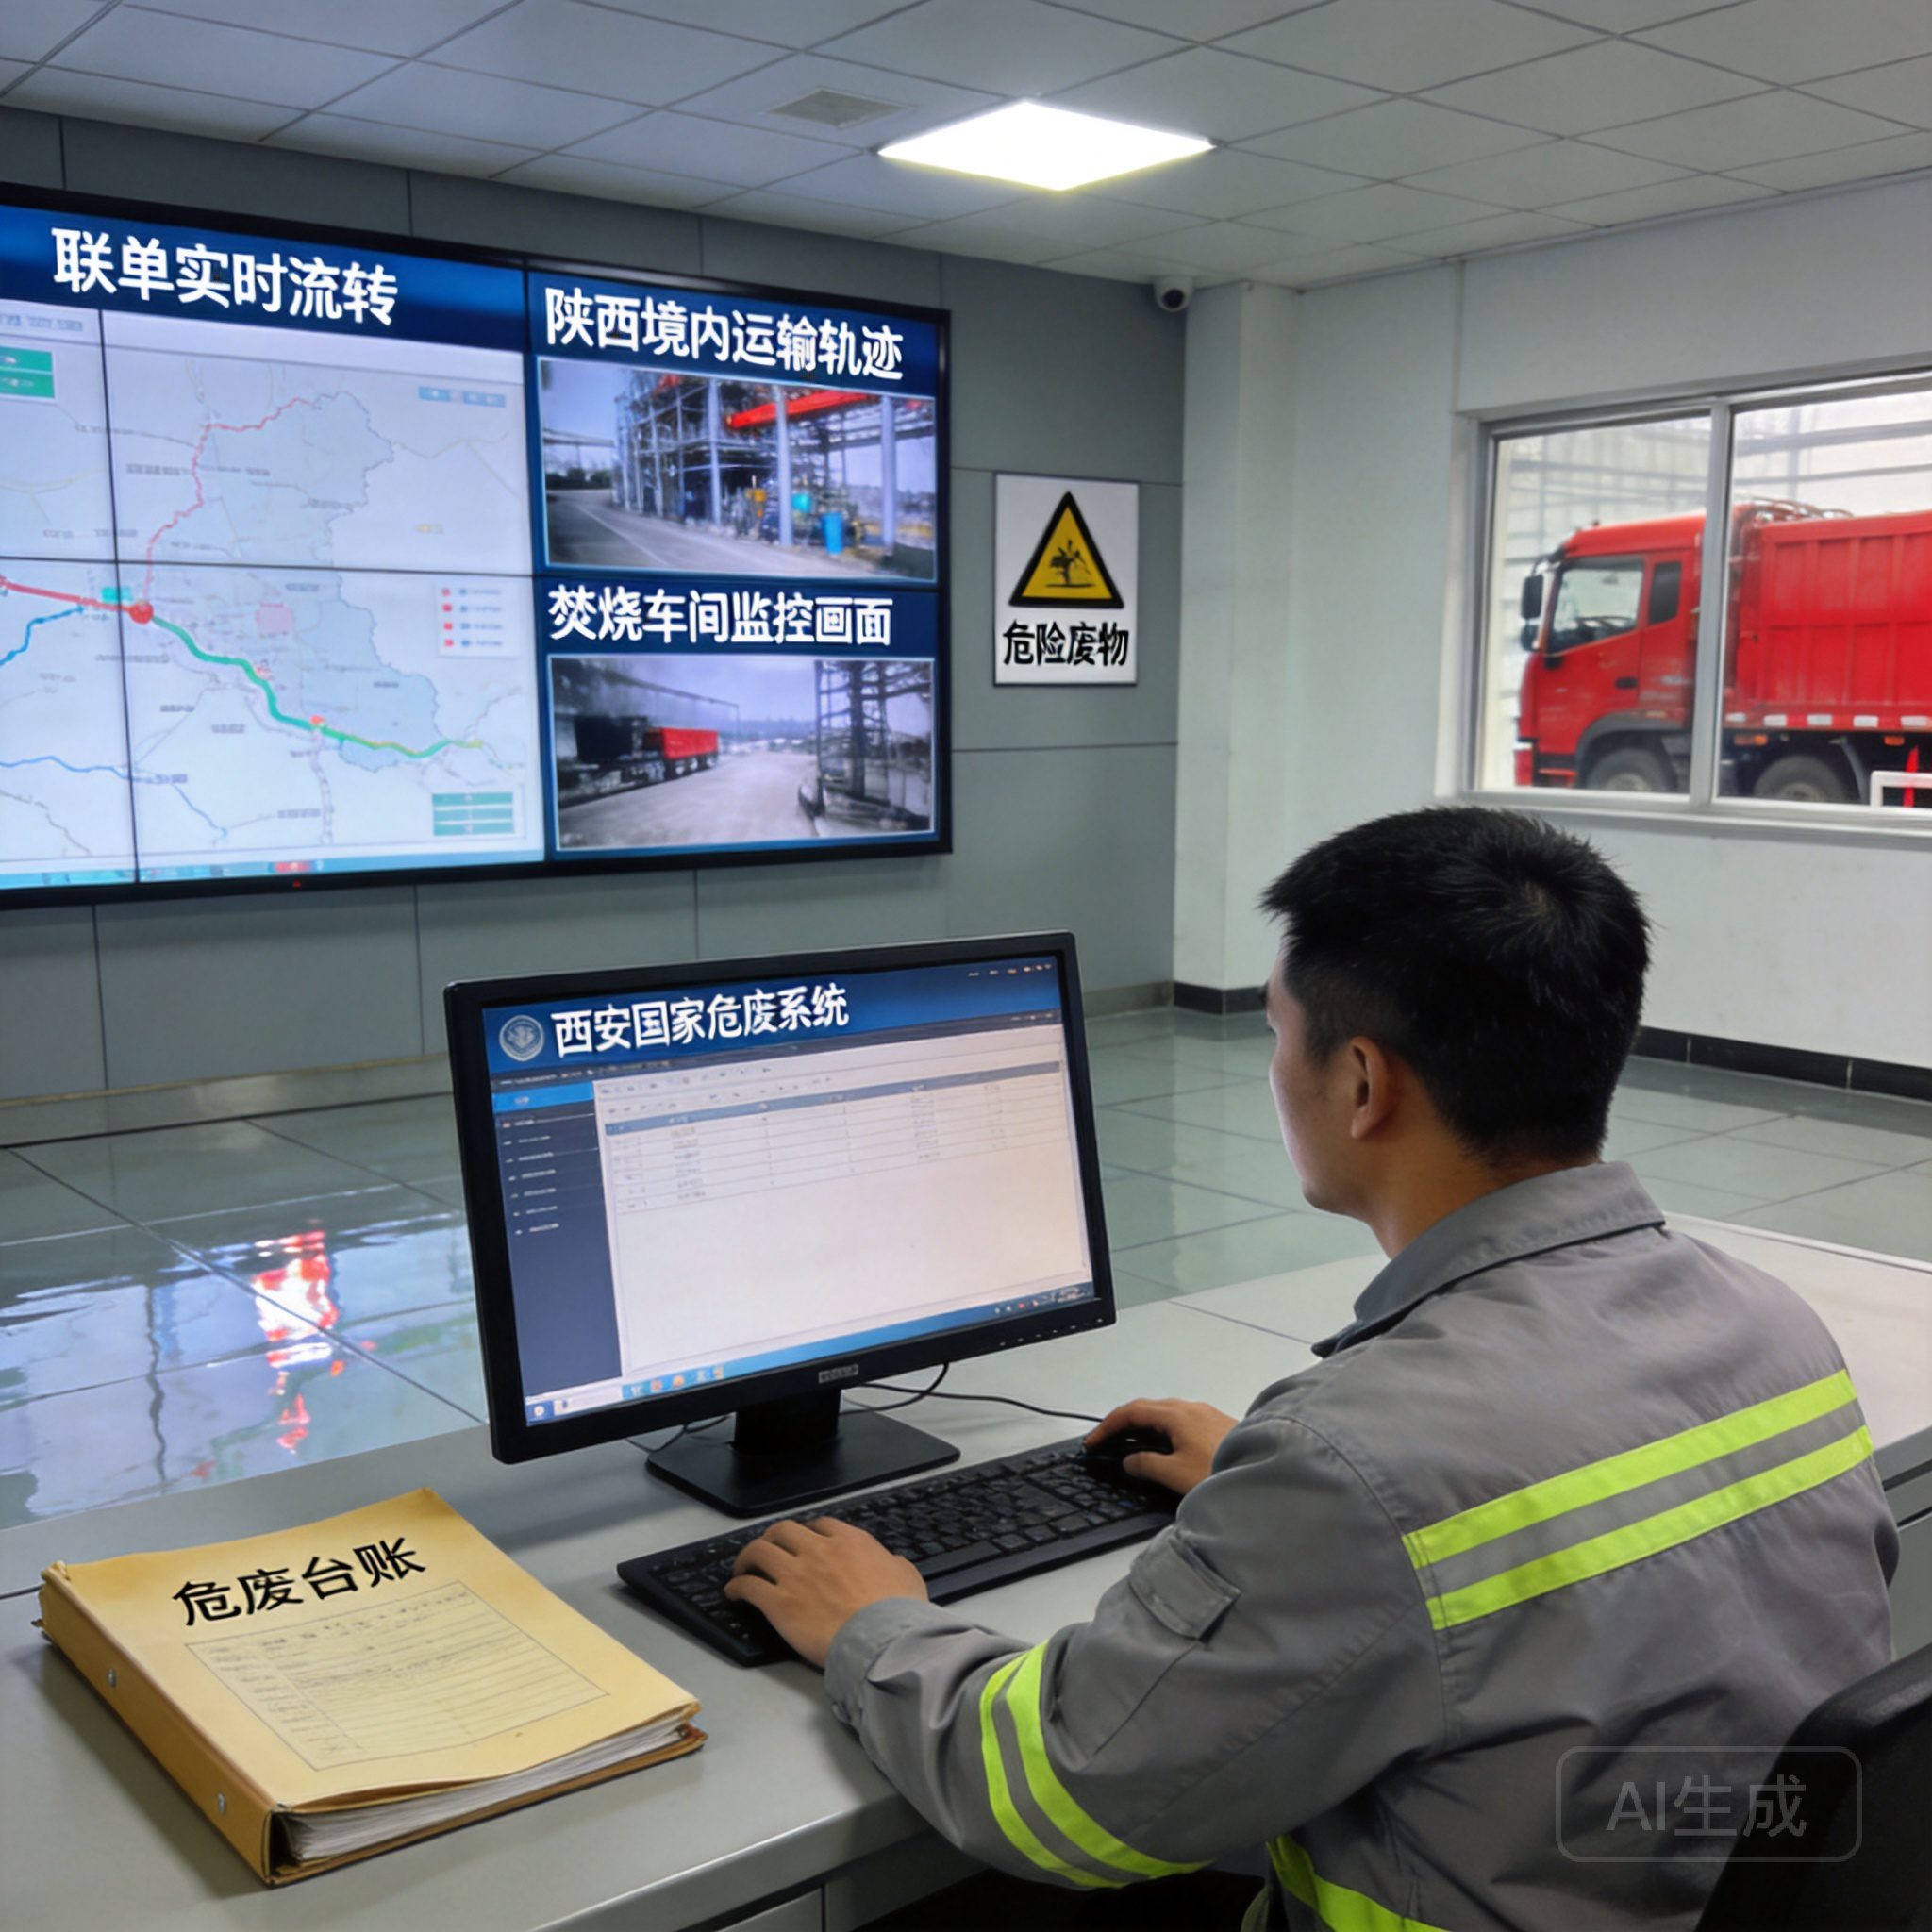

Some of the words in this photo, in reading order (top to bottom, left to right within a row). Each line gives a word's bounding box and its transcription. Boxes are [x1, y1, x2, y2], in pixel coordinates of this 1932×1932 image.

[51, 227, 398, 326] 联单实时流转
[544, 287, 904, 381] 陕西境内运输轨迹
[548, 584, 893, 646] 焚烧车间监控画面
[1003, 620, 1129, 666] 危险废物
[550, 981, 850, 1059] 西安国家危废系统
[173, 1537, 426, 1626] 危废台账
